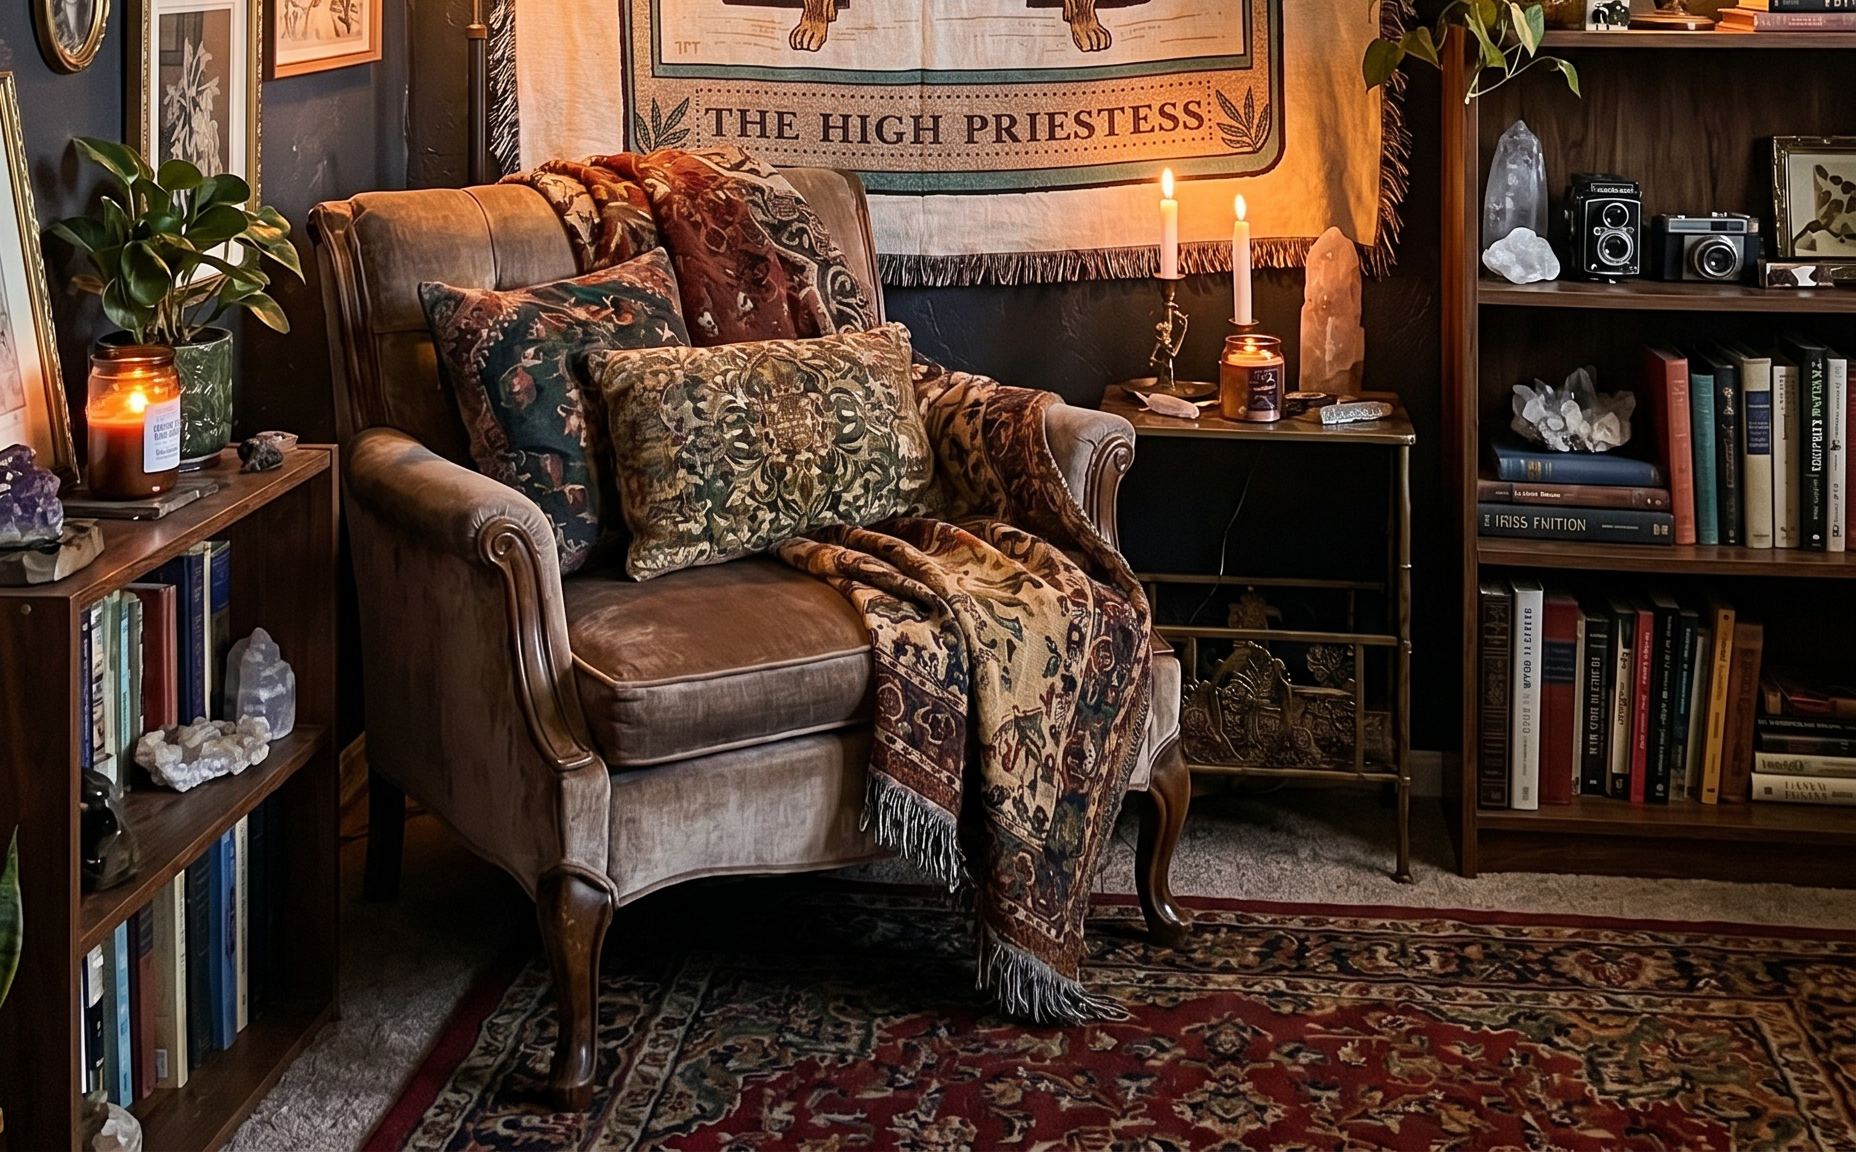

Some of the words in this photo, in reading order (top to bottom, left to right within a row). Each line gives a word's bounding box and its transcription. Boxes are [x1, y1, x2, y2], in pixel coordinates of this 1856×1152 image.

[705, 107, 800, 141] THE
[819, 111, 942, 145] HIGH
[963, 99, 1206, 145] PRIESTESS
